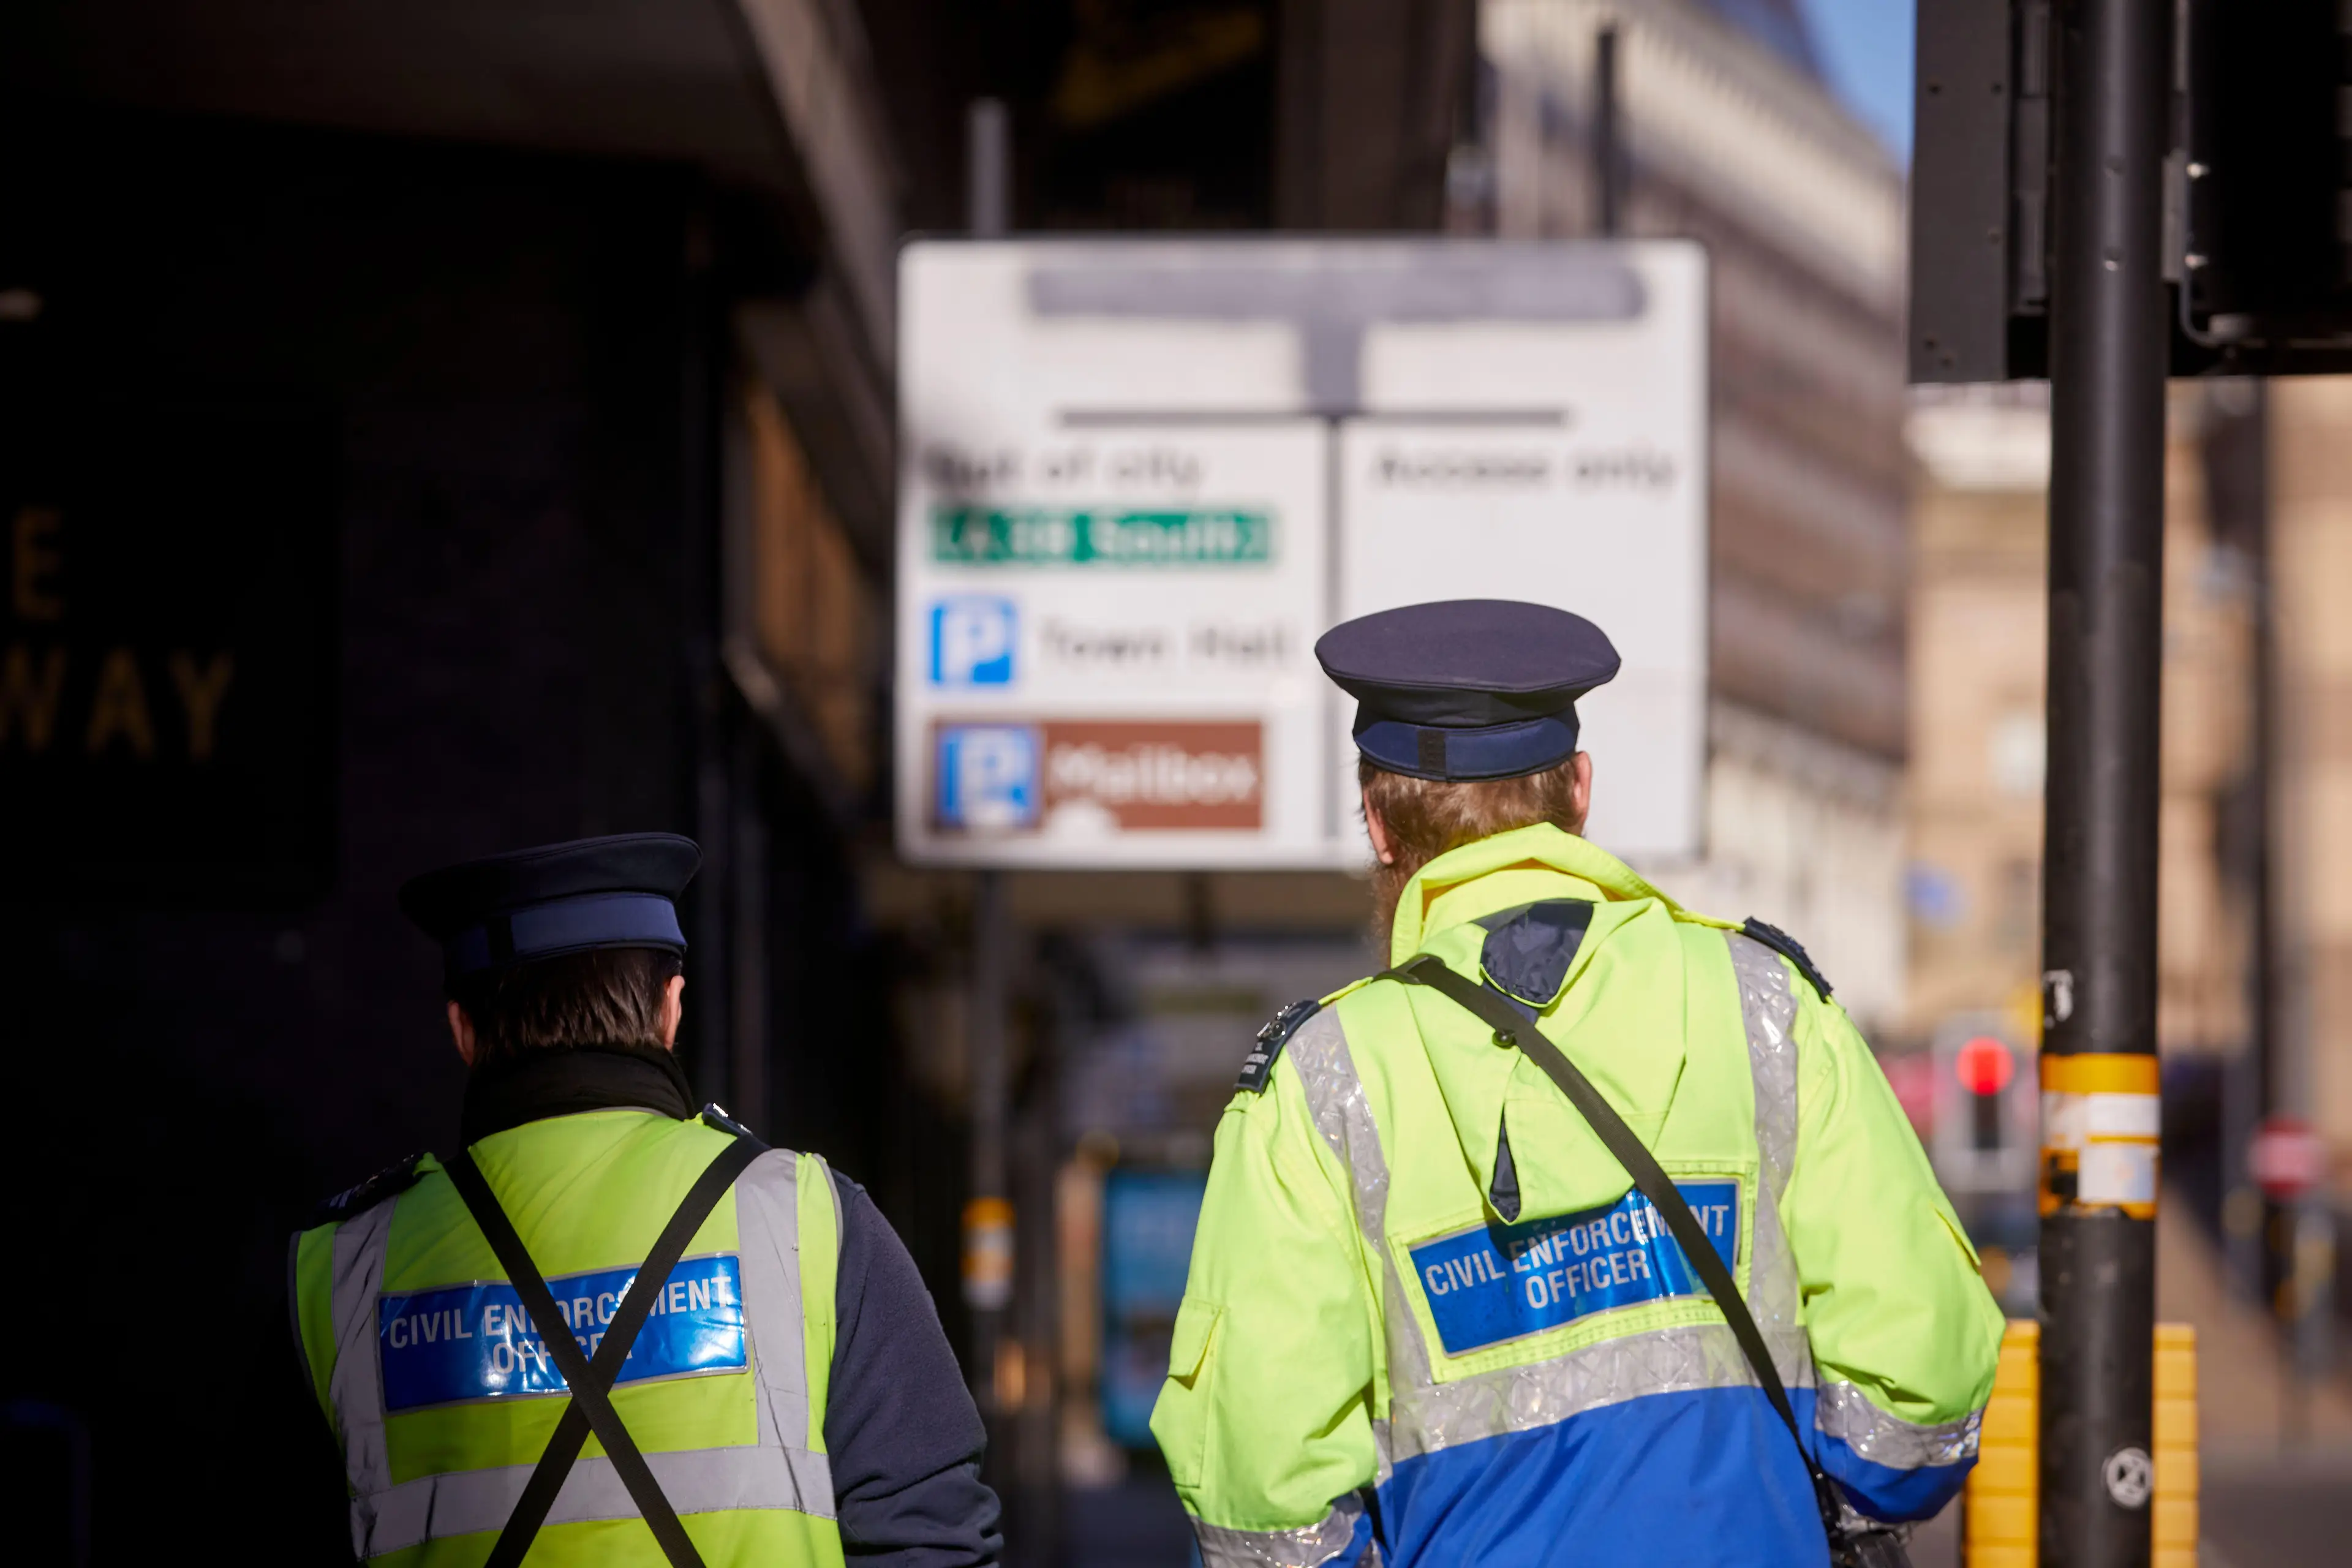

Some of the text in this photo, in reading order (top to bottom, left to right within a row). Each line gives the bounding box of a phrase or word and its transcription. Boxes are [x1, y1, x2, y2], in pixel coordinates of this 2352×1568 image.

[1042, 620, 1167, 662] Town
[1050, 744, 1258, 805] Mailbox
[1425, 1204, 1730, 1296] CIVIL ENFORCEMNT
[1525, 1248, 1651, 1310] OFFICER
[389, 1308, 473, 1349] CIVIL
